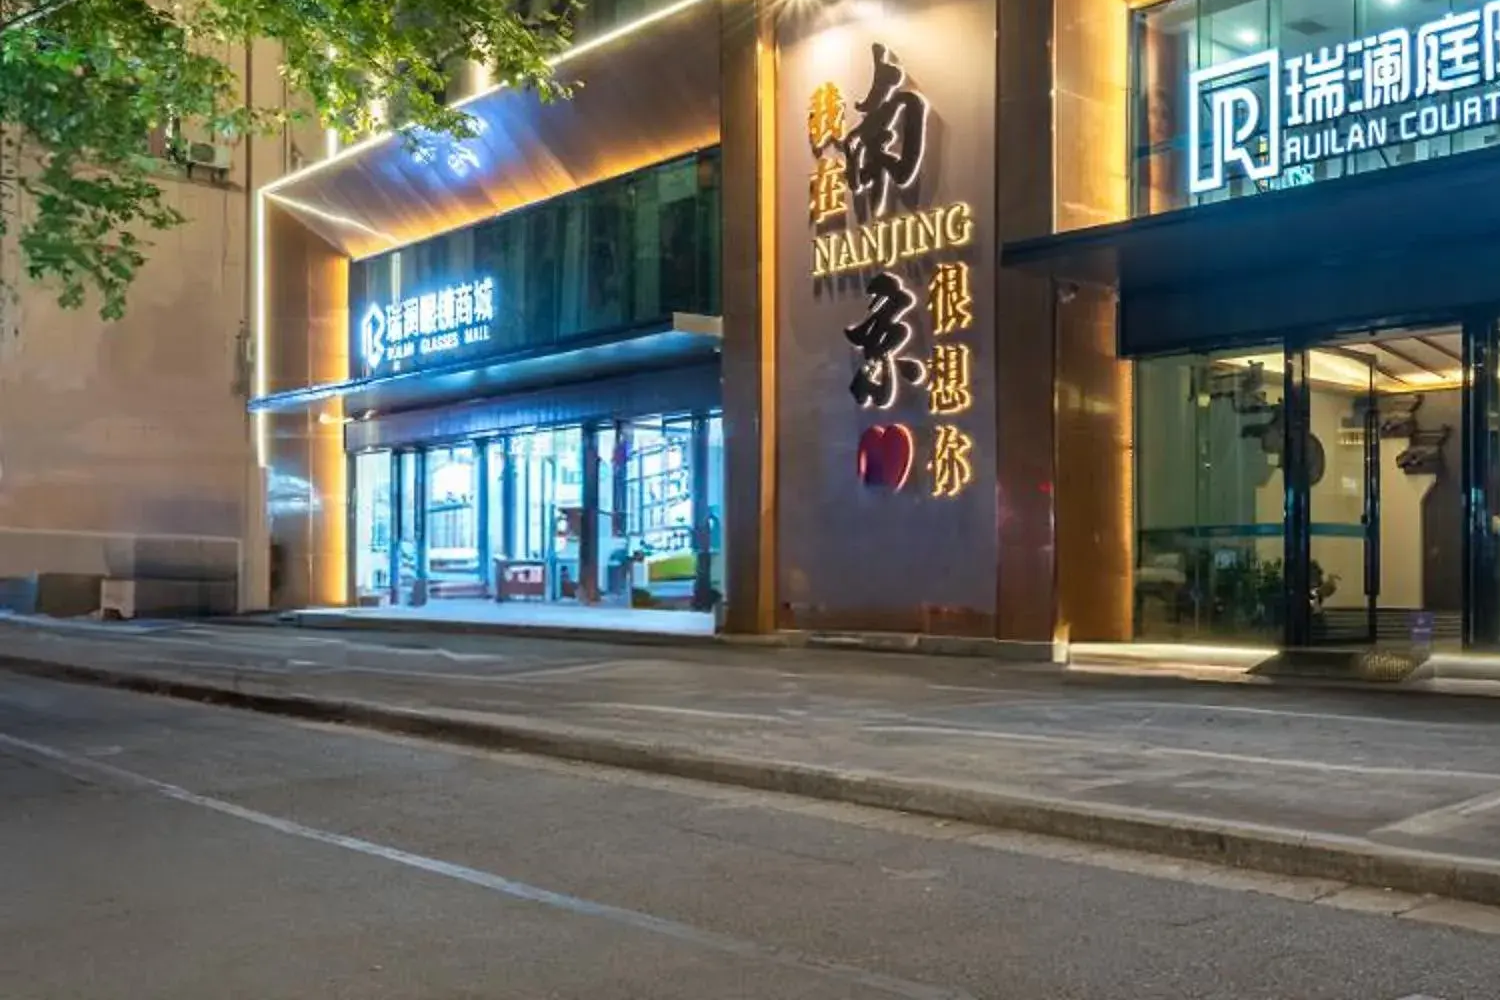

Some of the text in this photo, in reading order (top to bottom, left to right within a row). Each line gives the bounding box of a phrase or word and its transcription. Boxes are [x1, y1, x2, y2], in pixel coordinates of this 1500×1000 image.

[1283, 118, 1387, 165] RUILAN
[812, 202, 974, 276] NANJING
[927, 262, 973, 498] 很想你
